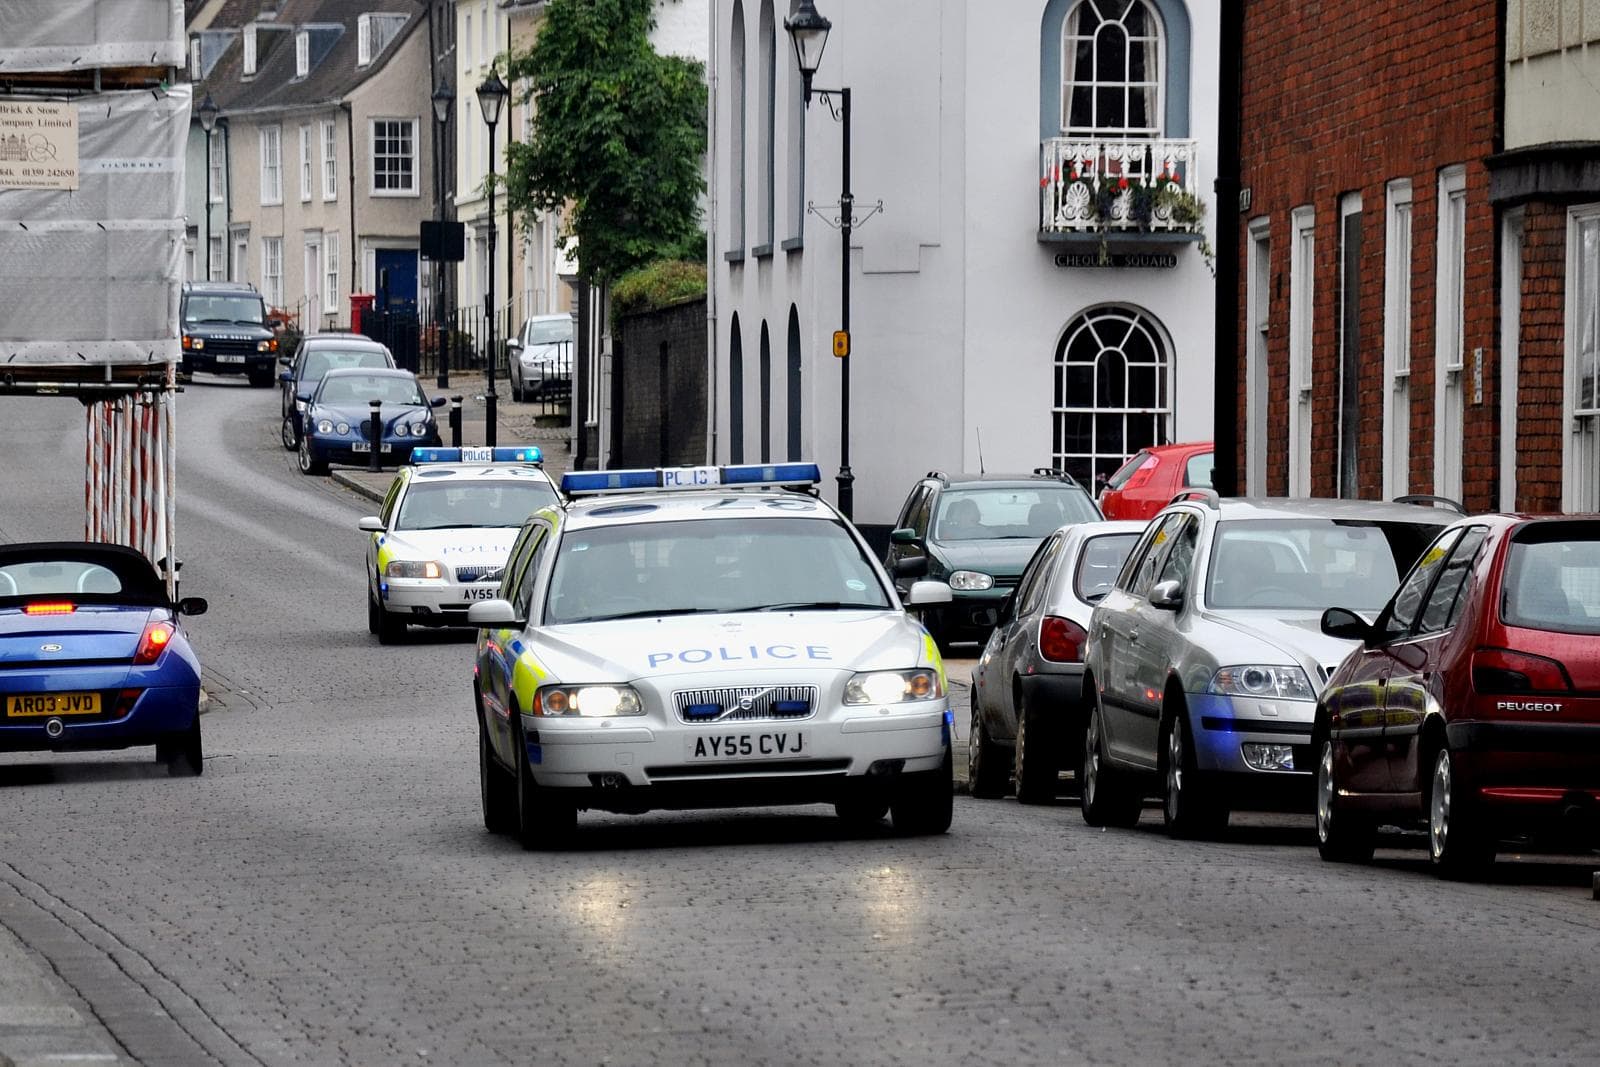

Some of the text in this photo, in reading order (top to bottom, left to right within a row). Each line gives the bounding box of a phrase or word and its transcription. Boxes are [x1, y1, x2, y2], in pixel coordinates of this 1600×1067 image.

[37, 106, 60, 114] Stone
[0, 119, 72, 129] ompany Limited
[1057, 255, 1174, 267] CHEQUR SQUARE
[463, 450, 491, 461] POLICE
[443, 545, 508, 555] POLIC
[463, 589, 493, 600] AY55
[648, 645, 832, 668] POLICE
[13, 695, 93, 713] AR03 JVD
[1496, 702, 1563, 712] PEUGEOT
[694, 732, 803, 757] AY55 CVJ
